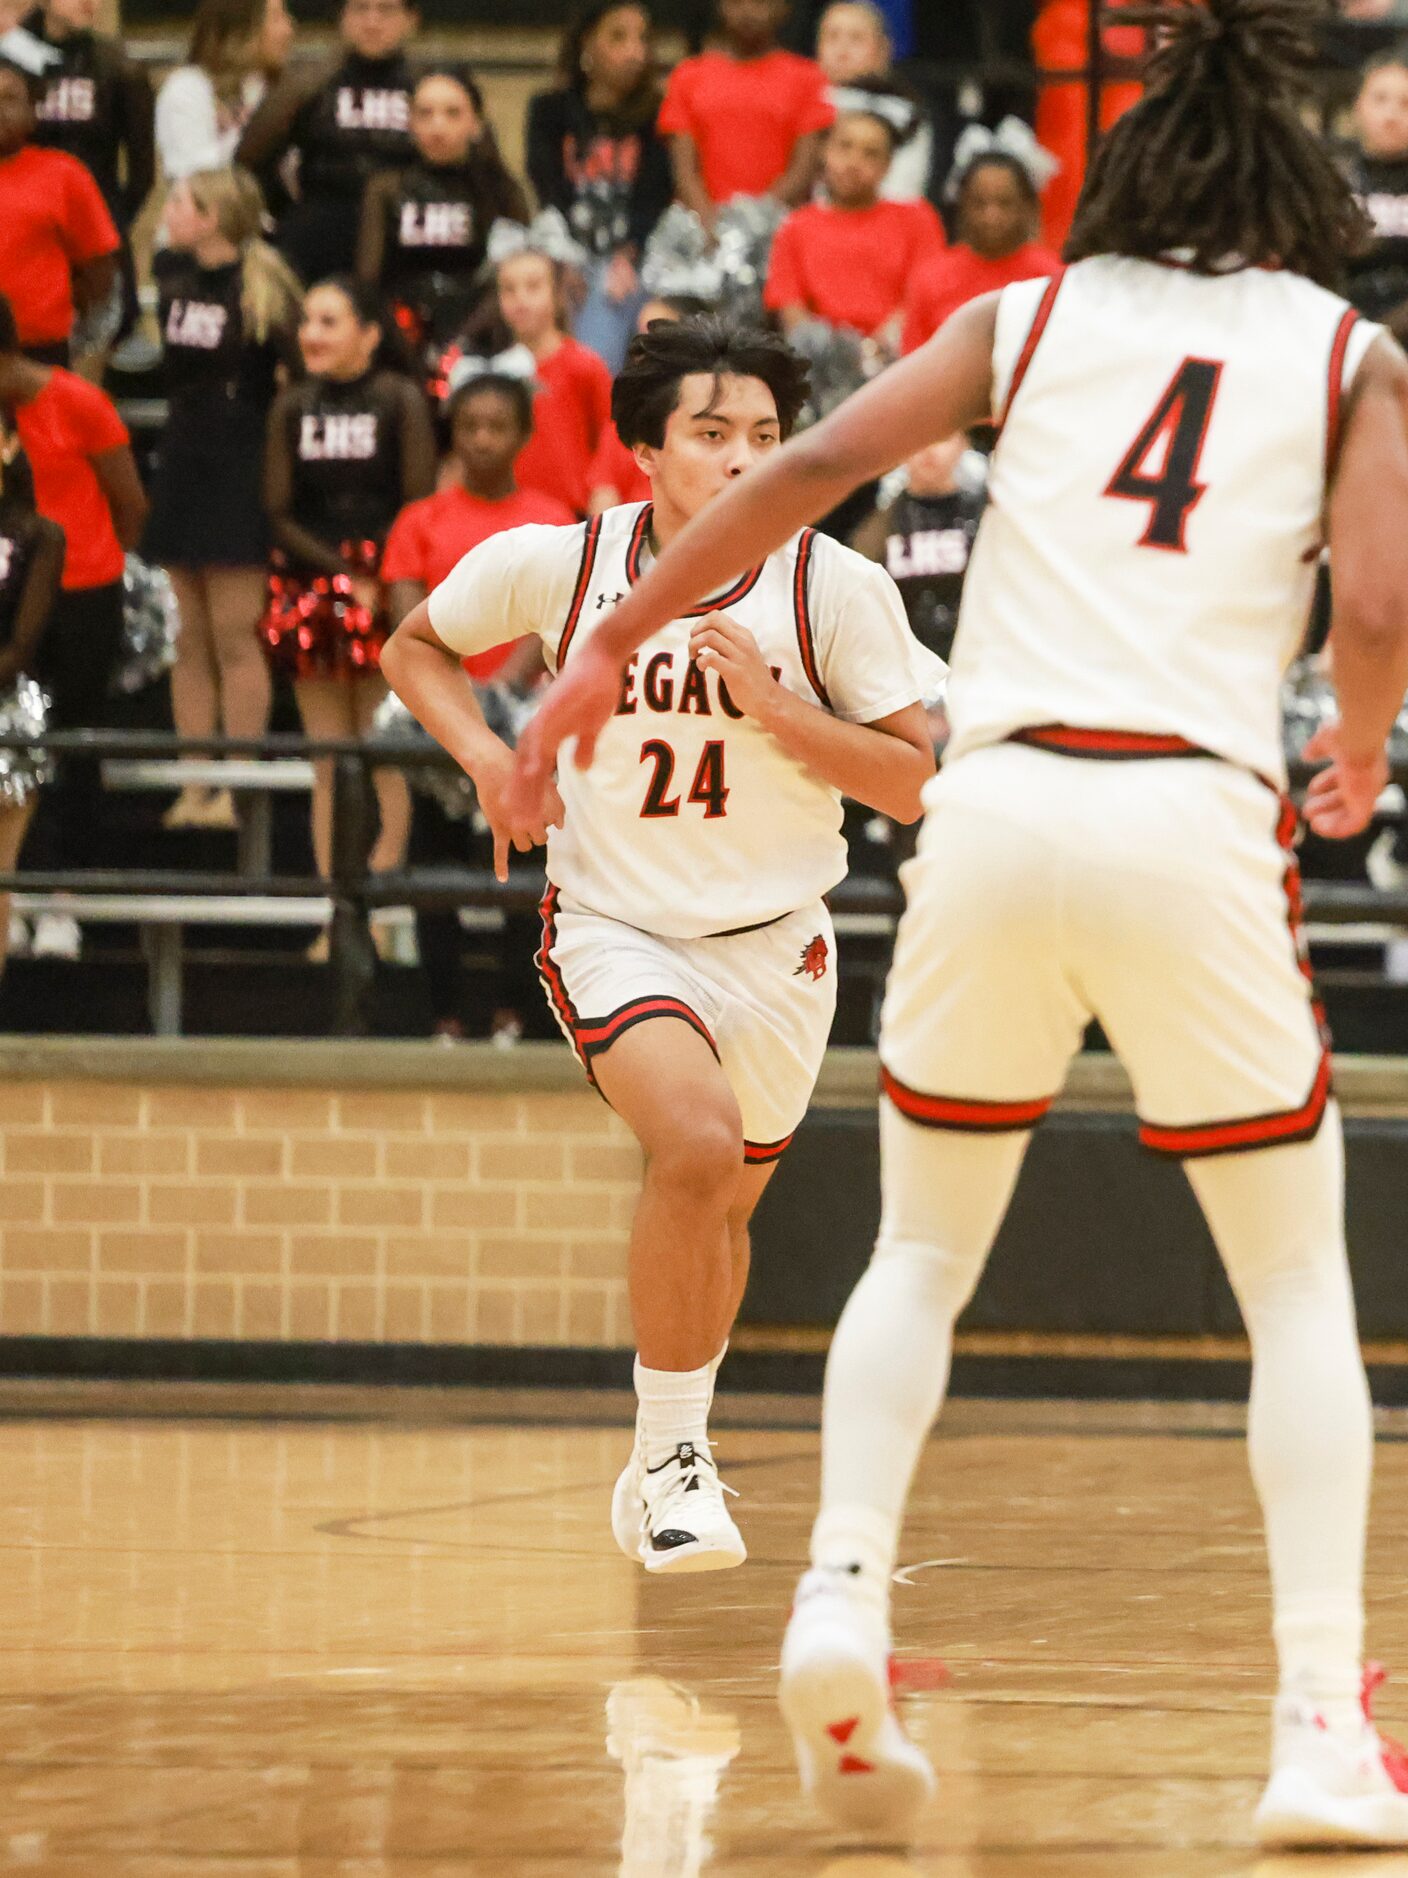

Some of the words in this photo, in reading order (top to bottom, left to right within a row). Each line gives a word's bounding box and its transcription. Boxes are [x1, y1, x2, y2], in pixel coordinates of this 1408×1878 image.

[400, 202, 474, 247] LHS
[167, 299, 227, 349] LHS
[300, 412, 378, 461] LHS
[1101, 356, 1225, 555] 4
[886, 530, 968, 579] LHS
[639, 738, 730, 819] 24
